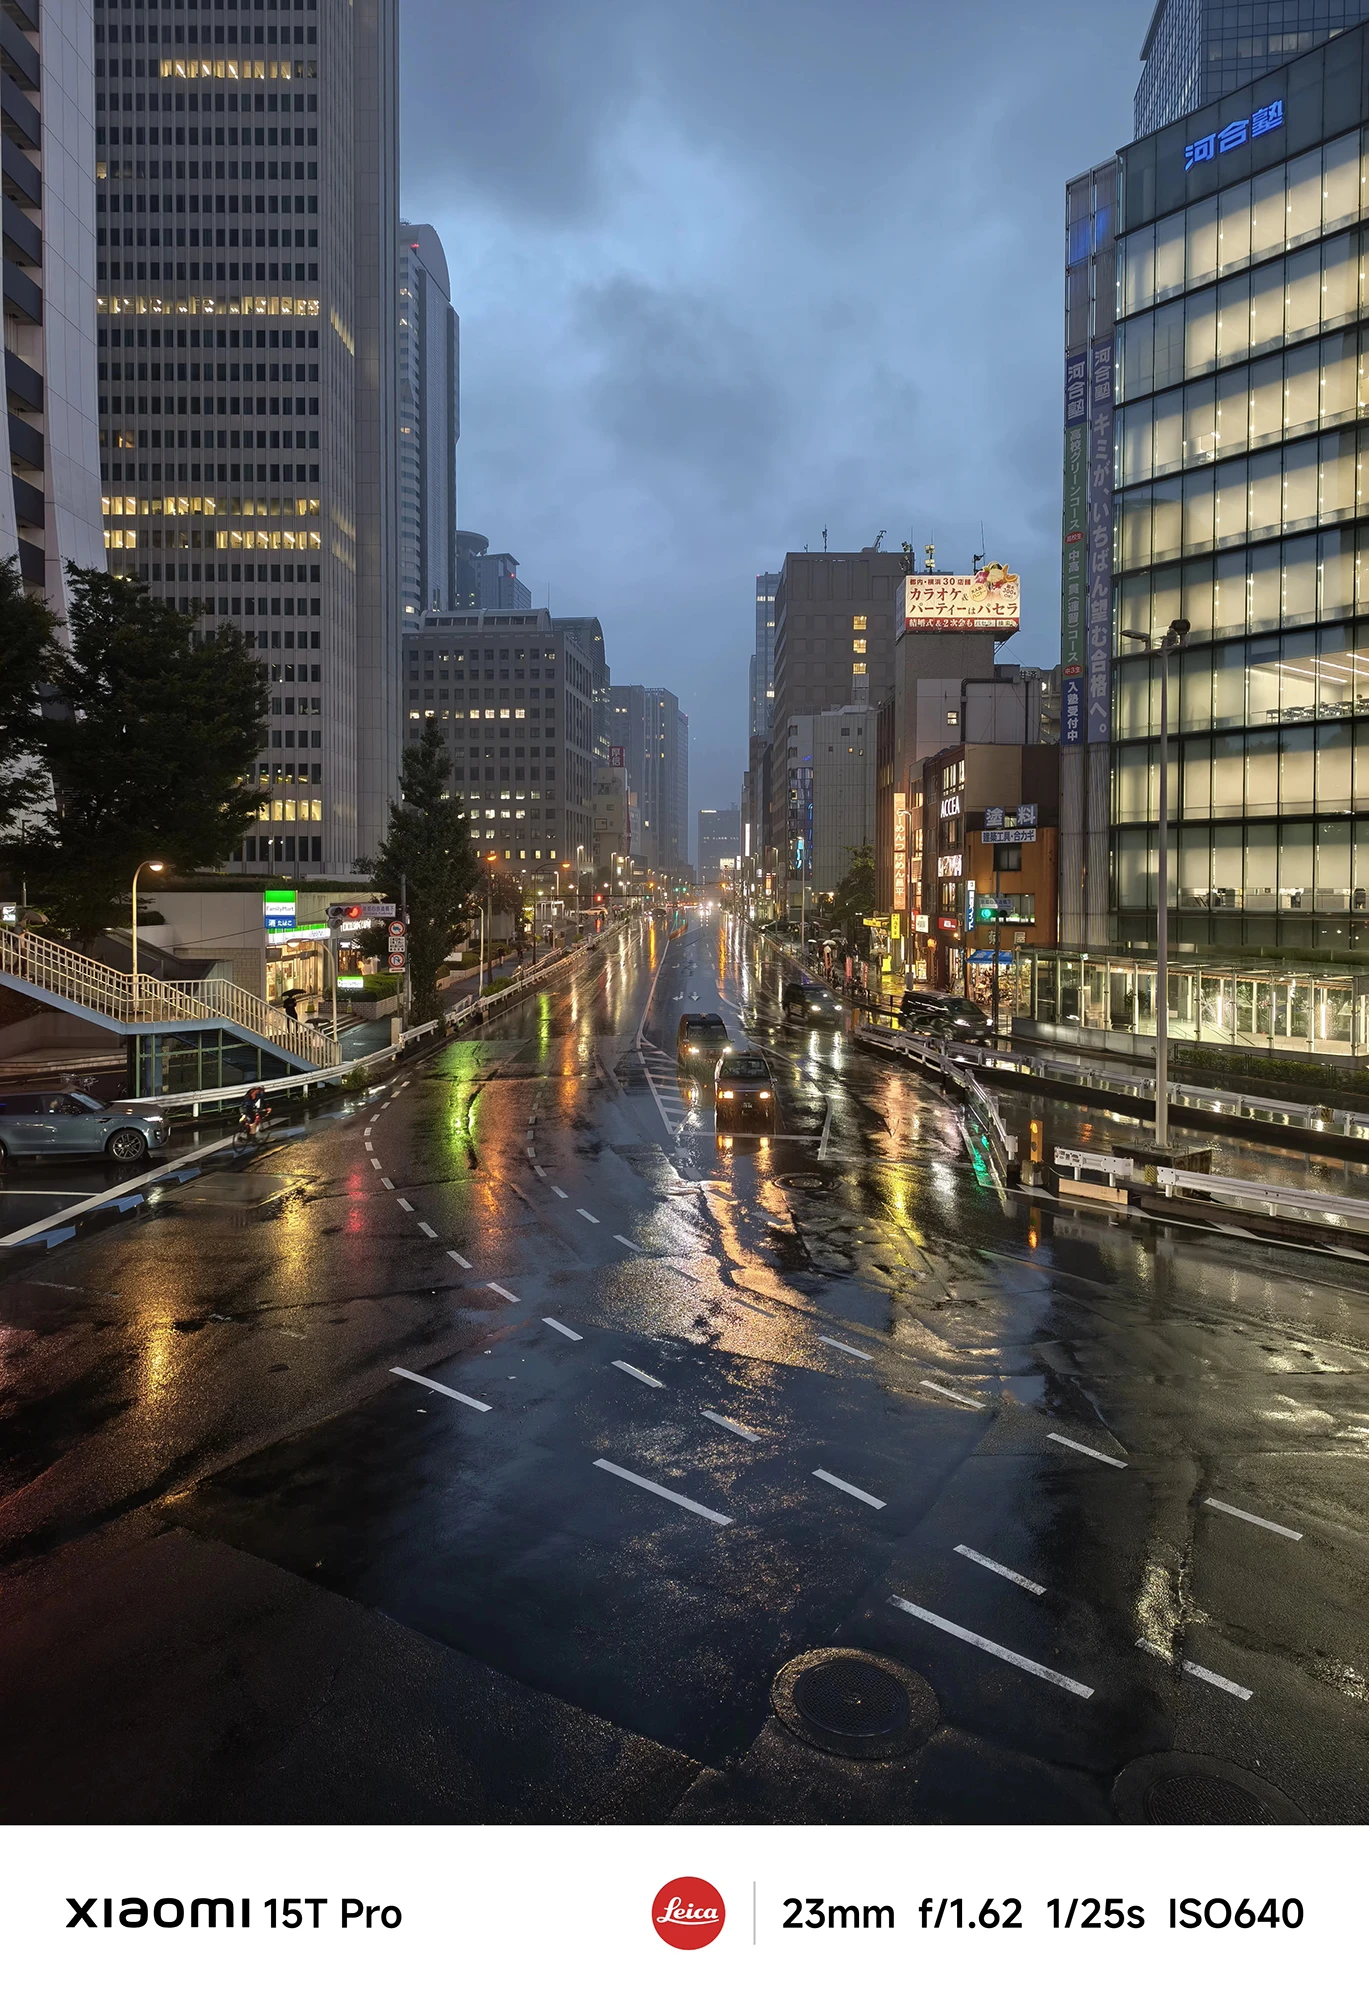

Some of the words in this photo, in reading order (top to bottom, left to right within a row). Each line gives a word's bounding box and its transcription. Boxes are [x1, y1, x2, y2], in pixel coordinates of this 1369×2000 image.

[1185, 100, 1283, 171] 河合塾
[1067, 361, 1086, 421] 河合塾
[1094, 346, 1111, 402] 河合塾
[1069, 428, 1082, 530] 高校グリーンコース
[909, 602, 1018, 616] パーティーはパセラ
[1067, 681, 1079, 742] 入塾受付中
[941, 796, 960, 818] ACCEA
[986, 805, 1036, 827] 塗料
[983, 830, 1035, 842] 建築工具・合カギ
